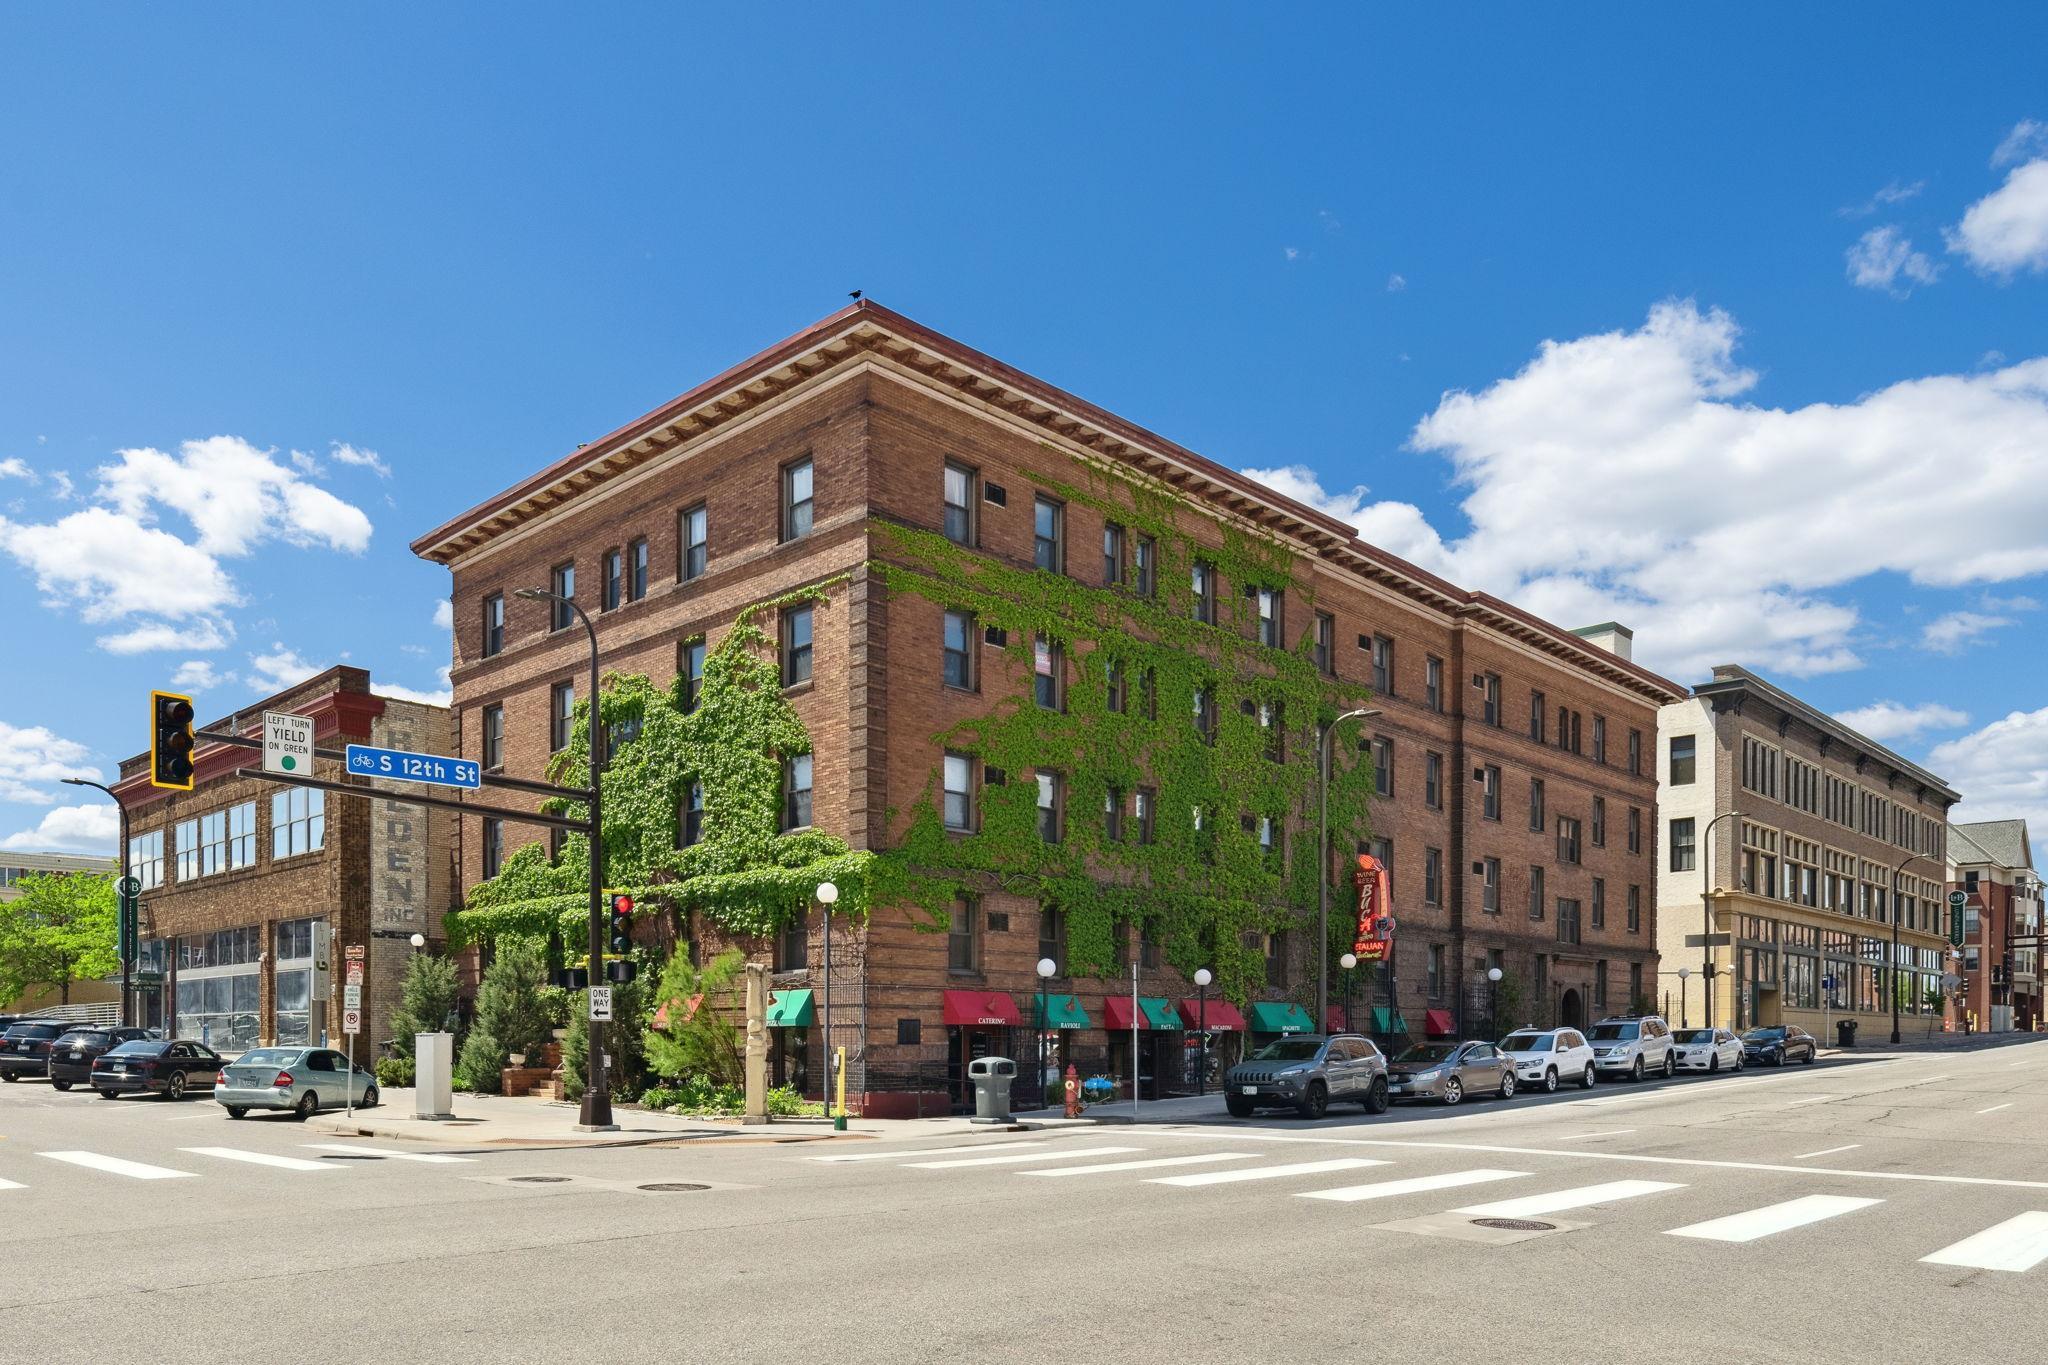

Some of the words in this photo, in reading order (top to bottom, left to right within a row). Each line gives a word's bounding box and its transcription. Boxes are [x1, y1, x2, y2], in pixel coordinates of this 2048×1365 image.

[267, 715, 286, 726] LEFT
[290, 718, 310, 729] TURN
[272, 727, 306, 743] YIELD
[268, 741, 279, 750] ON
[283, 743, 308, 754] GREEN
[380, 755, 392, 772] S
[402, 758, 445, 779] 12th
[455, 765, 476, 783] St
[1360, 884, 1373, 932] BUCA
[1355, 941, 1384, 951] ITALIAN
[592, 989, 609, 998] ONE
[593, 999, 610, 1007] WAY
[978, 1017, 1006, 1025] CATERING
